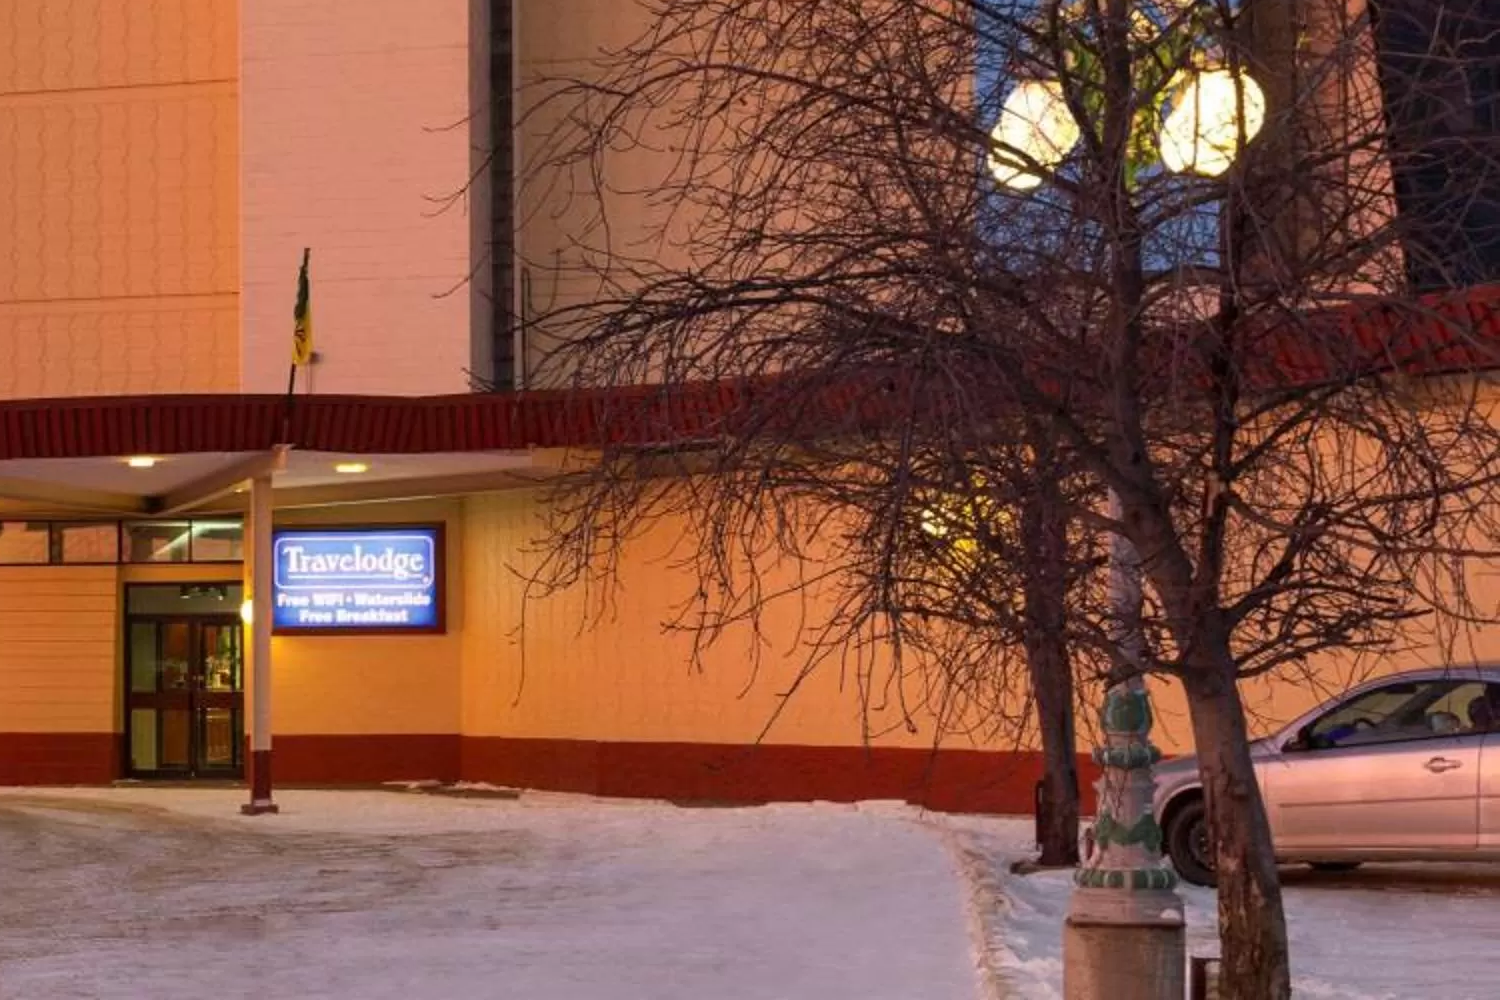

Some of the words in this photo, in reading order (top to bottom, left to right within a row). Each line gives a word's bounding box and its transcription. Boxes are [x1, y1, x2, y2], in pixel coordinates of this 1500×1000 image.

[282, 543, 425, 580] Travelodge
[299, 609, 333, 623] Free
[336, 608, 409, 624] Breakfast
